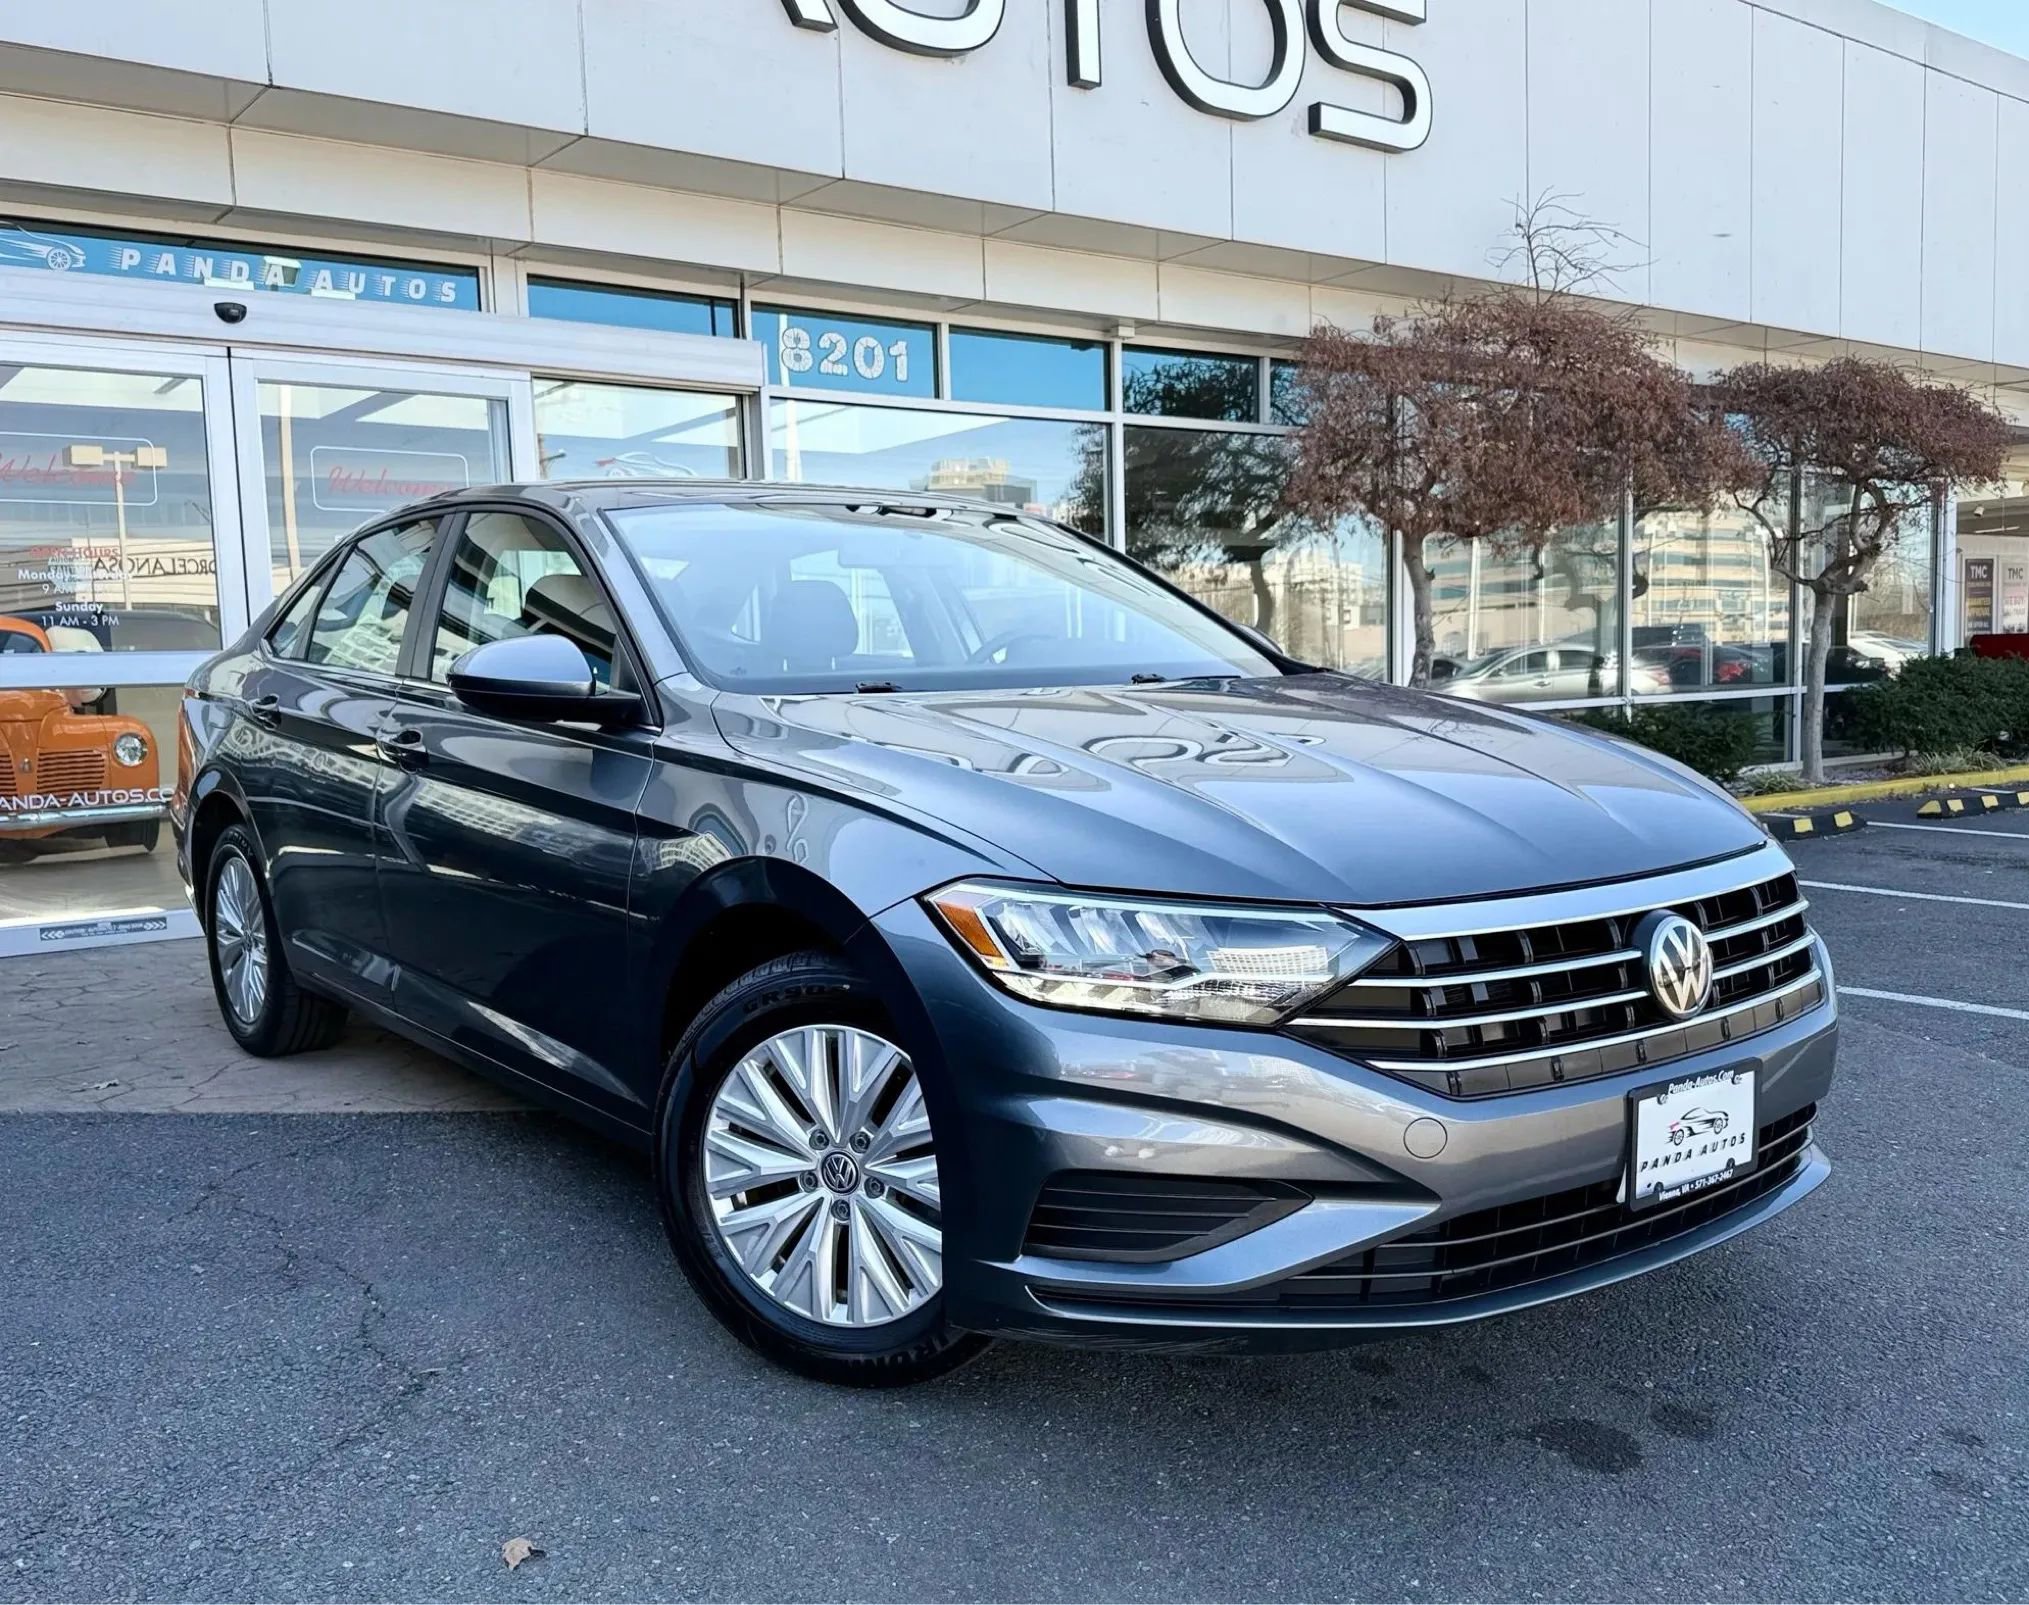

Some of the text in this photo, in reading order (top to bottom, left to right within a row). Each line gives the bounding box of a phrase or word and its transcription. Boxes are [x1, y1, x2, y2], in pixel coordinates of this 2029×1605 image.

[112, 247, 457, 304] PANDA AUTOS
[781, 327, 908, 382] 8201
[1969, 564, 1988, 579] TMC
[2007, 567, 2024, 580] TMC
[55, 601, 104, 614] Sunday
[41, 615, 54, 626] 11
[60, 616, 79, 625] AM
[91, 615, 98, 626] 3
[102, 616, 120, 626] PM
[1640, 1132, 1746, 1172] PANDA AUTOS
